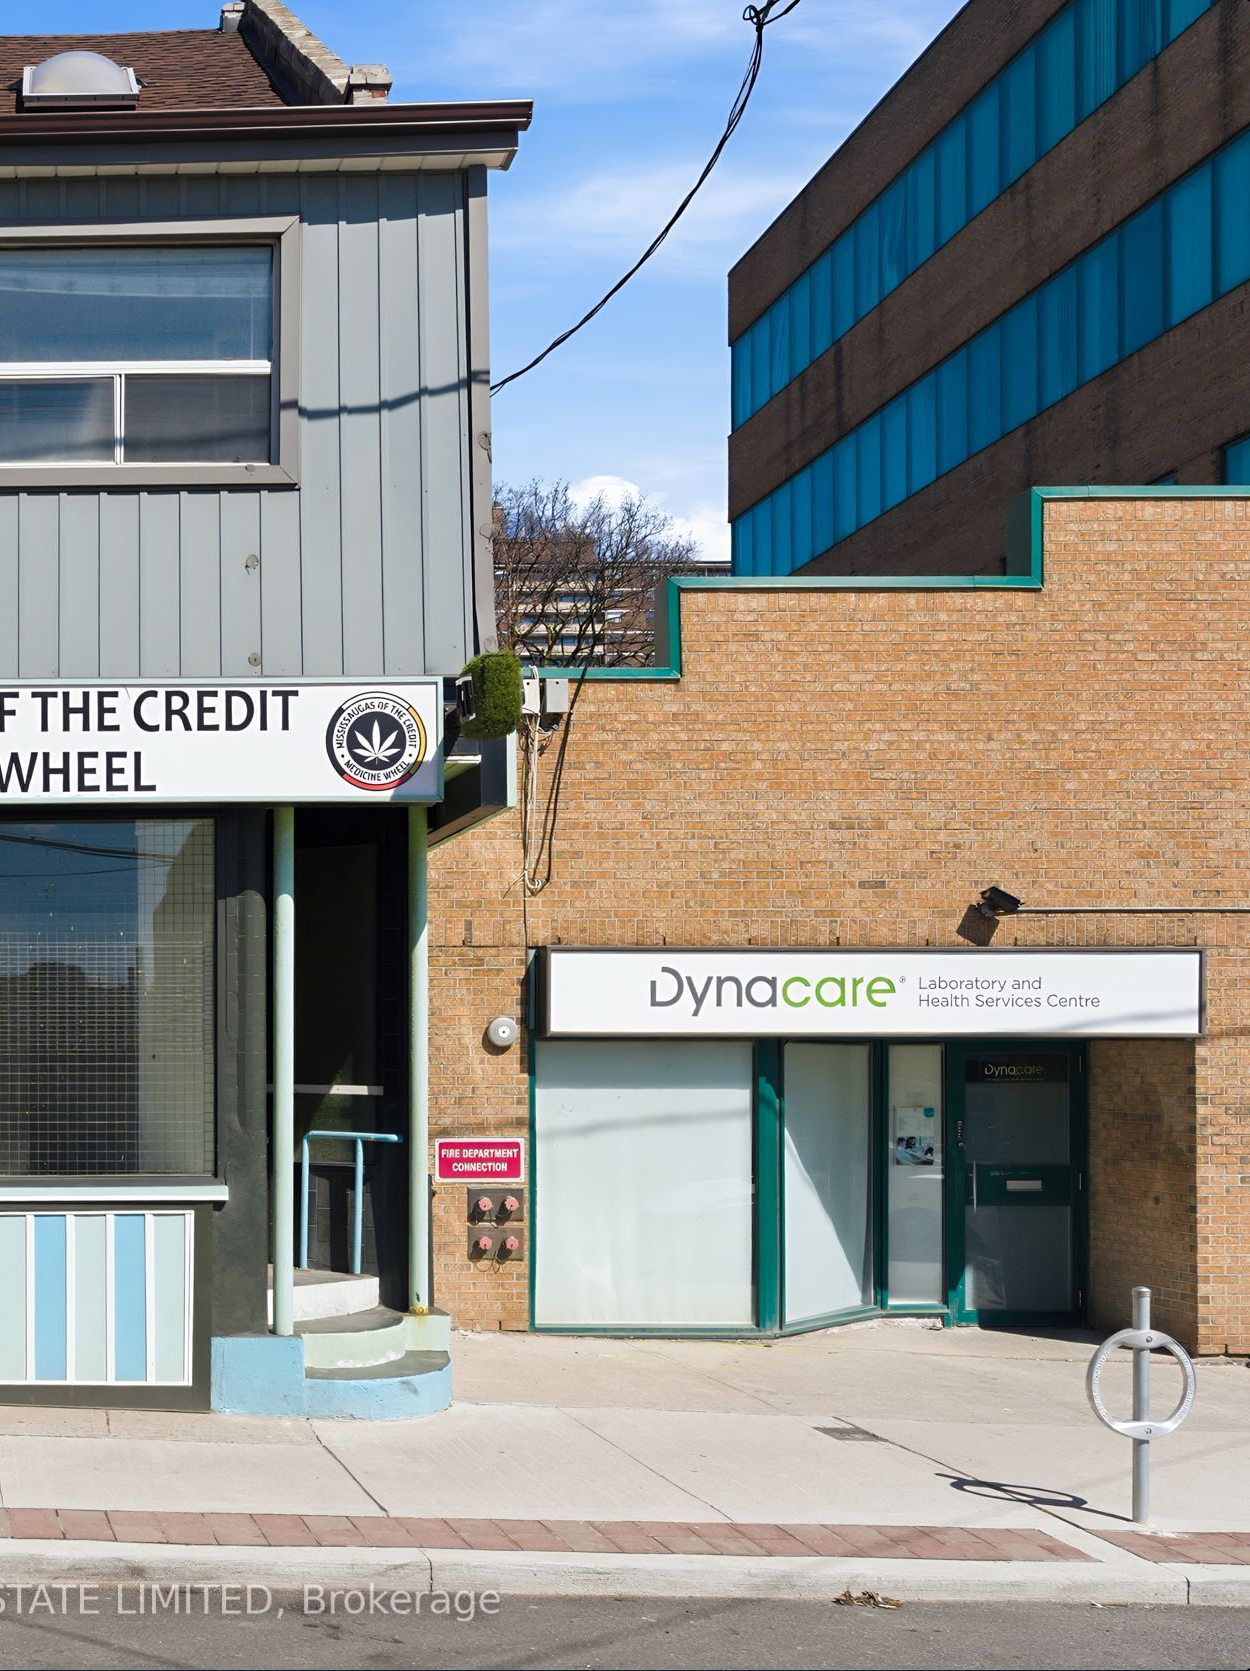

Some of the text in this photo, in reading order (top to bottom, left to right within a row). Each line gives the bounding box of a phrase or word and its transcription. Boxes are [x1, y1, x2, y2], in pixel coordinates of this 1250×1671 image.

[31, 691, 120, 732] THE
[133, 690, 300, 732] CREDIT
[336, 701, 375, 749] MISSISSAUGAS
[377, 701, 390, 710] OF
[390, 705, 406, 721] THE
[344, 760, 382, 782] MEDICINE
[919, 976, 1042, 993] Laboratory and
[919, 993, 1101, 1008] Health Services Centre
[441, 1148, 519, 1158] FIRE DEPARTMENT
[452, 1162, 508, 1172] CONNECTION
